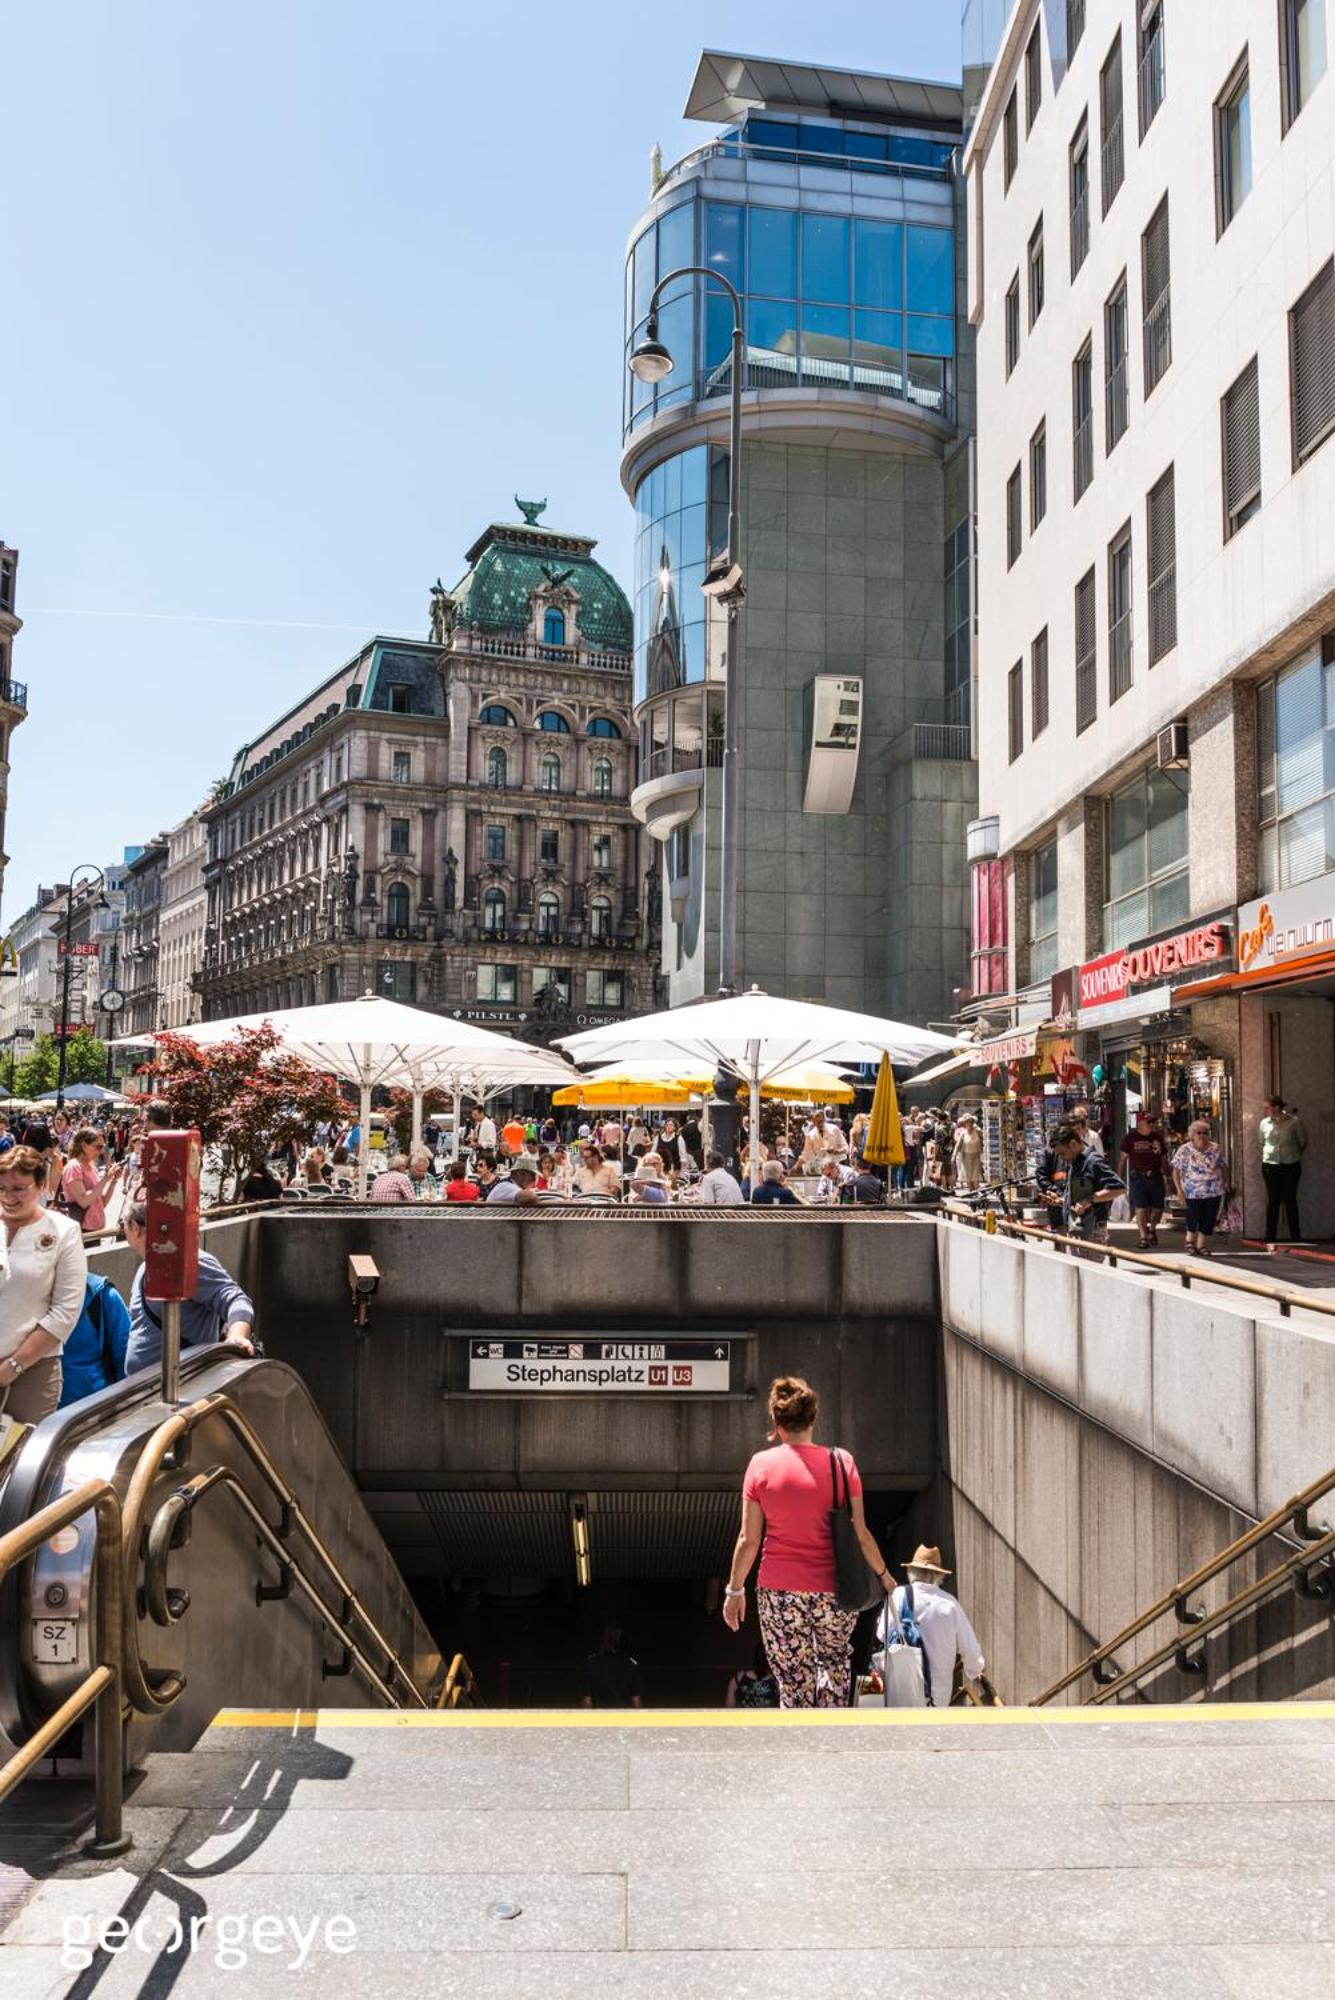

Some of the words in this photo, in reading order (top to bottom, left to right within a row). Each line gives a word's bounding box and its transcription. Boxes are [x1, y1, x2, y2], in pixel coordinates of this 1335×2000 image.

[61, 944, 97, 954] HBER
[1118, 922, 1221, 987] SOUVENIRS
[1081, 963, 1123, 1001] SOUVENIR
[506, 1364, 644, 1386] Stephansplatz
[651, 1368, 667, 1382] U1
[674, 1368, 692, 1382] U3
[43, 1625, 66, 1640] SZ
[51, 1643, 58, 1657] 1
